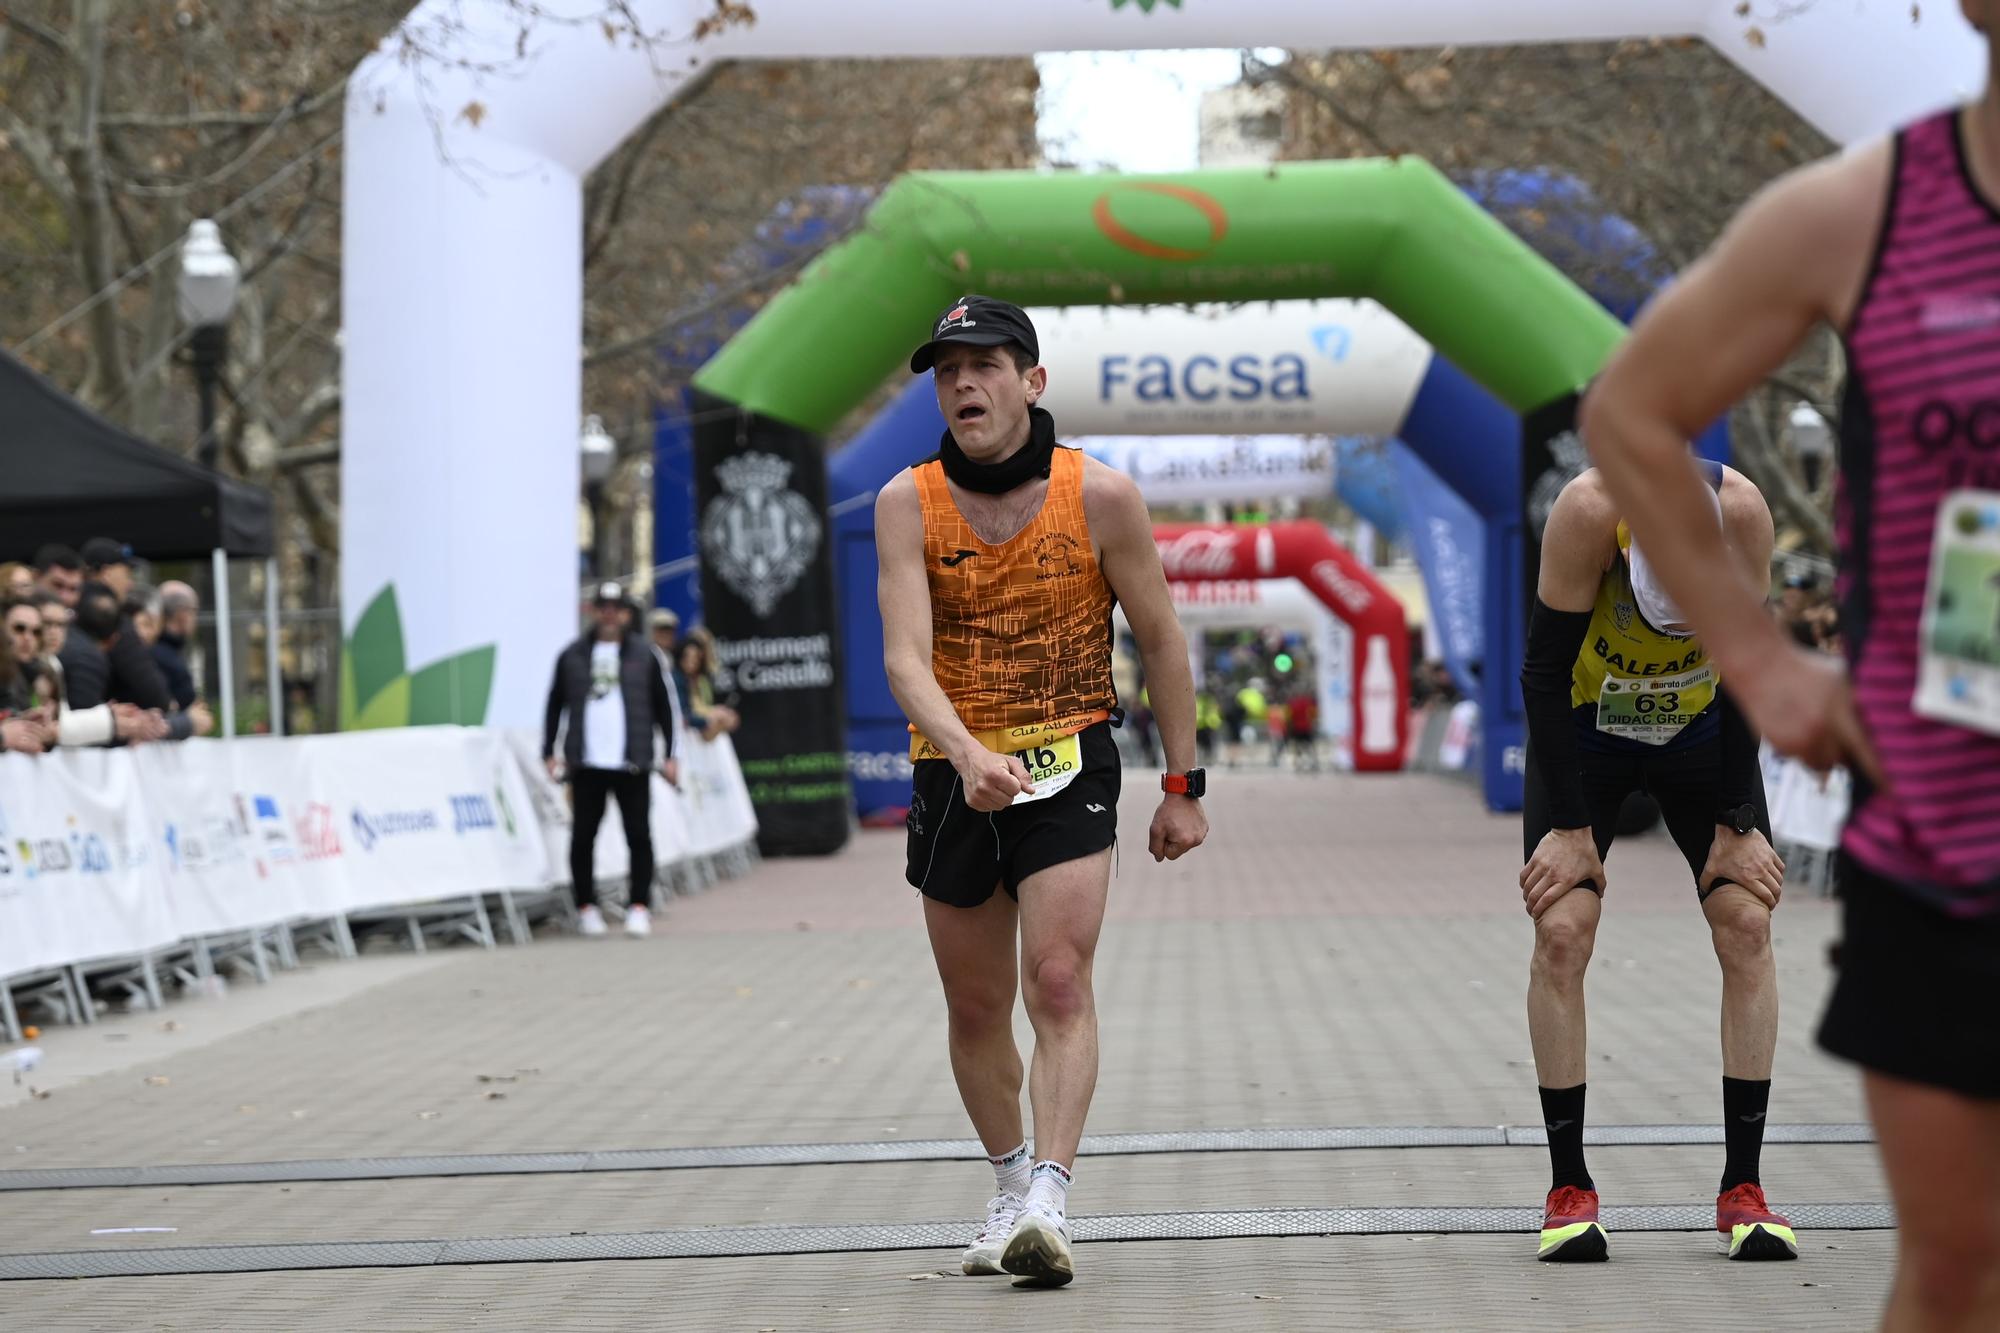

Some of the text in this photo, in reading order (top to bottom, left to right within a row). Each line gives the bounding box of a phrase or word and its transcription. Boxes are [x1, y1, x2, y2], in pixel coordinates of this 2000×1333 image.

[1634, 692, 1680, 714] 63
[1012, 717, 1093, 737] Club Atletisme
[1607, 714, 1652, 725] DIDAC
[1031, 761, 1072, 782] EDSO
